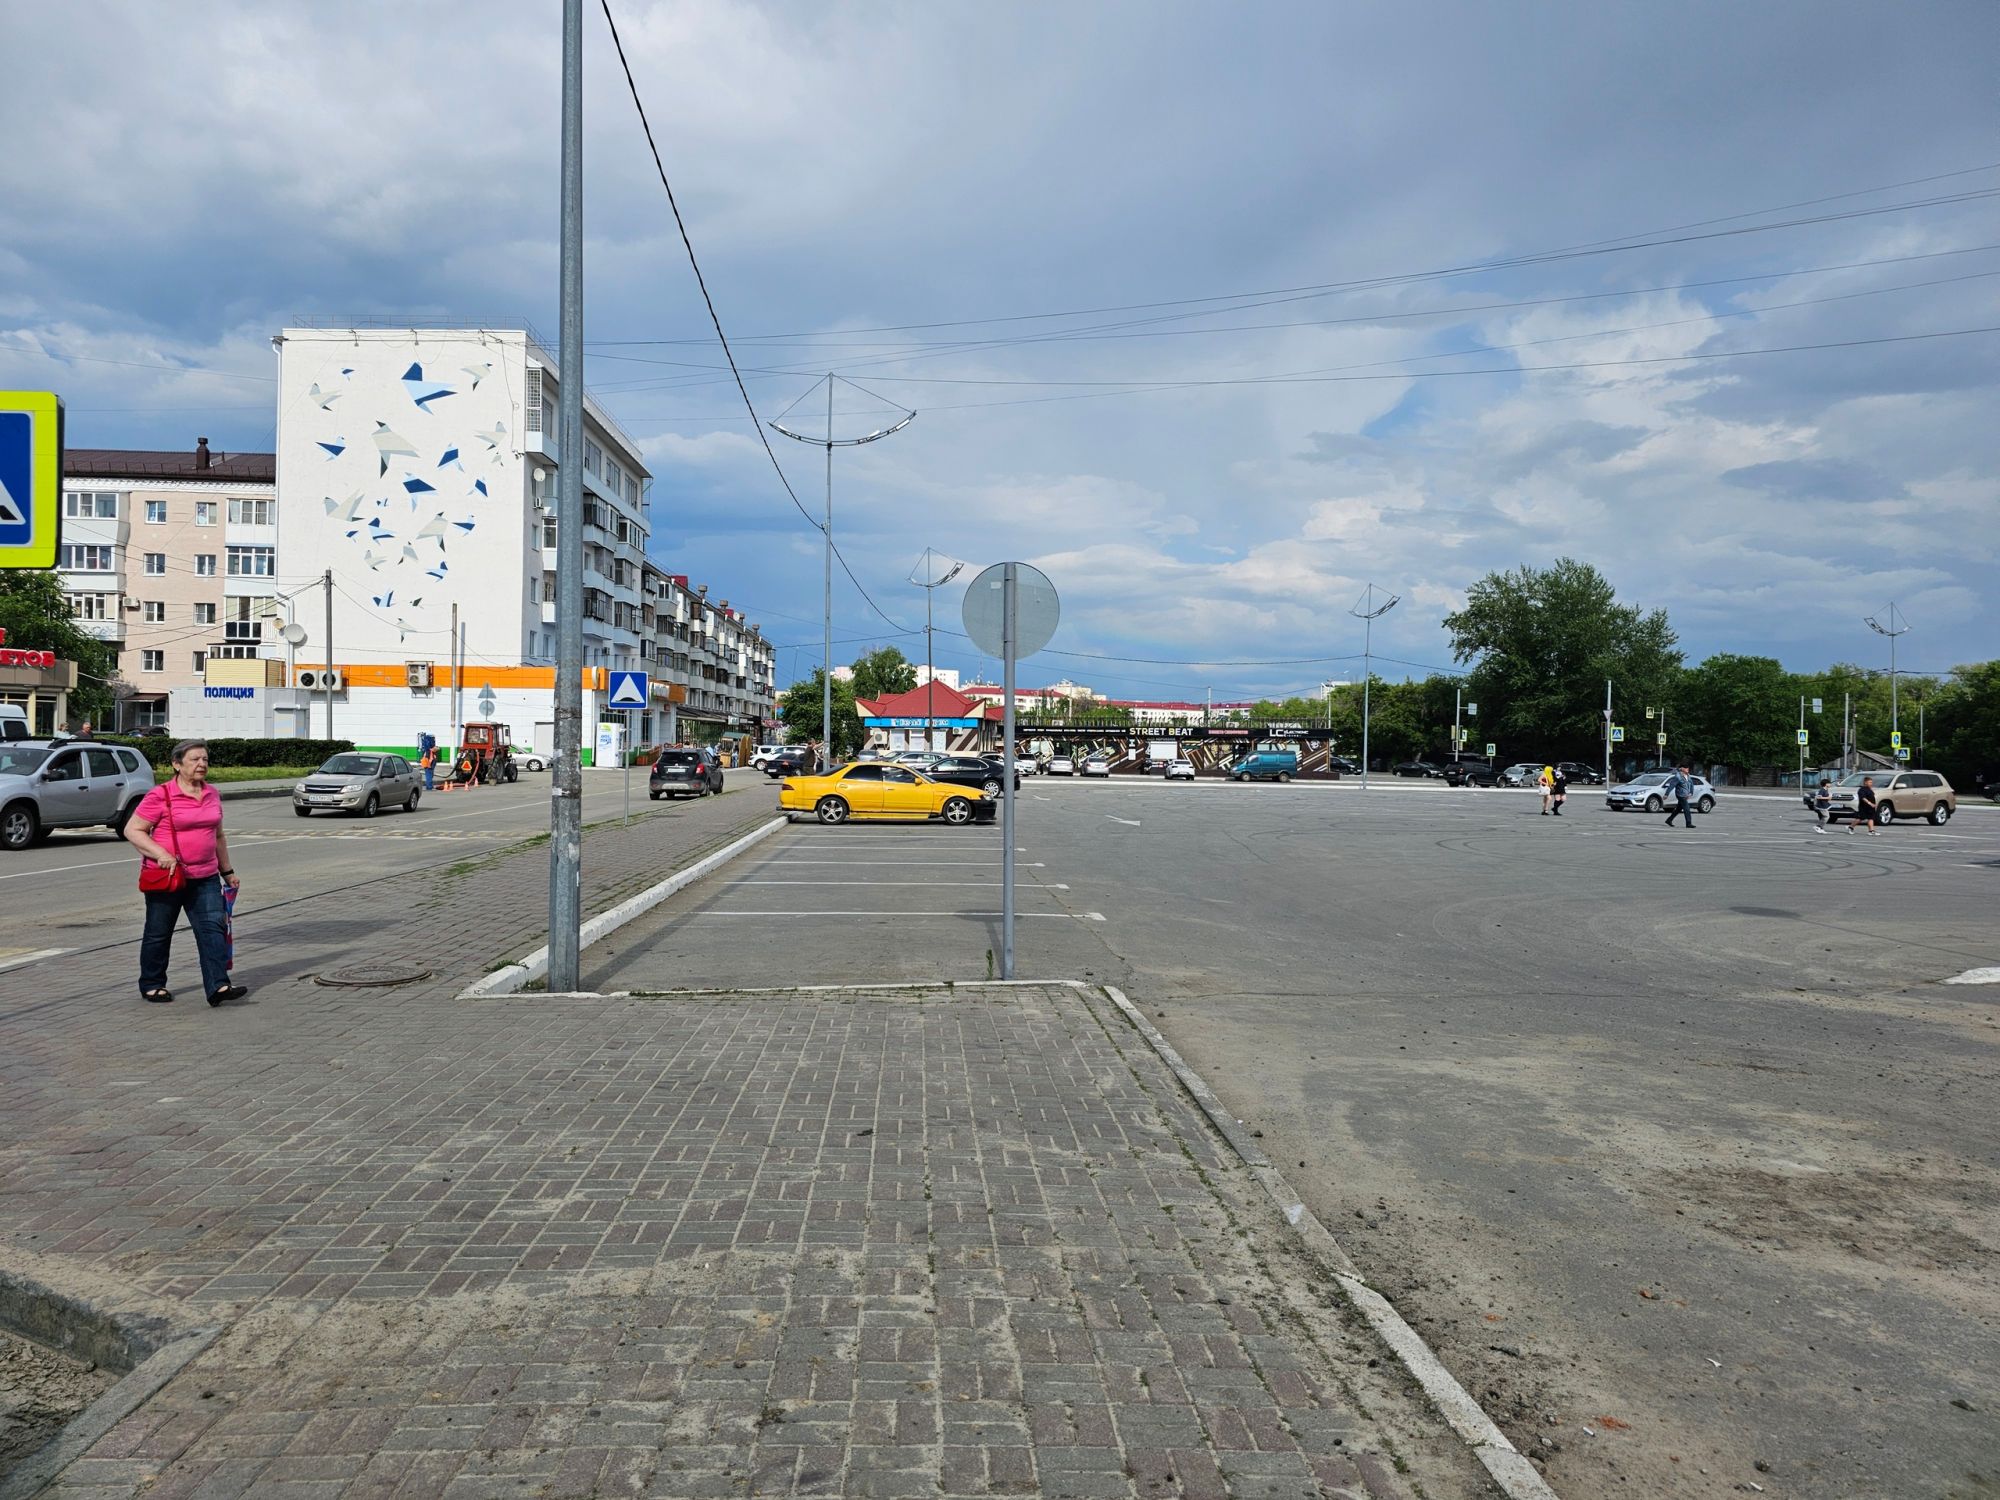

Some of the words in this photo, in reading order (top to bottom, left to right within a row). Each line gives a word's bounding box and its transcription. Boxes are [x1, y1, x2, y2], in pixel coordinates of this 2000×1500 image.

[204, 687, 255, 700] ПОЛИЦИЯ
[1129, 727, 1166, 736] STREET
[1168, 727, 1194, 736] BEAT
[1269, 728, 1284, 737] LC
